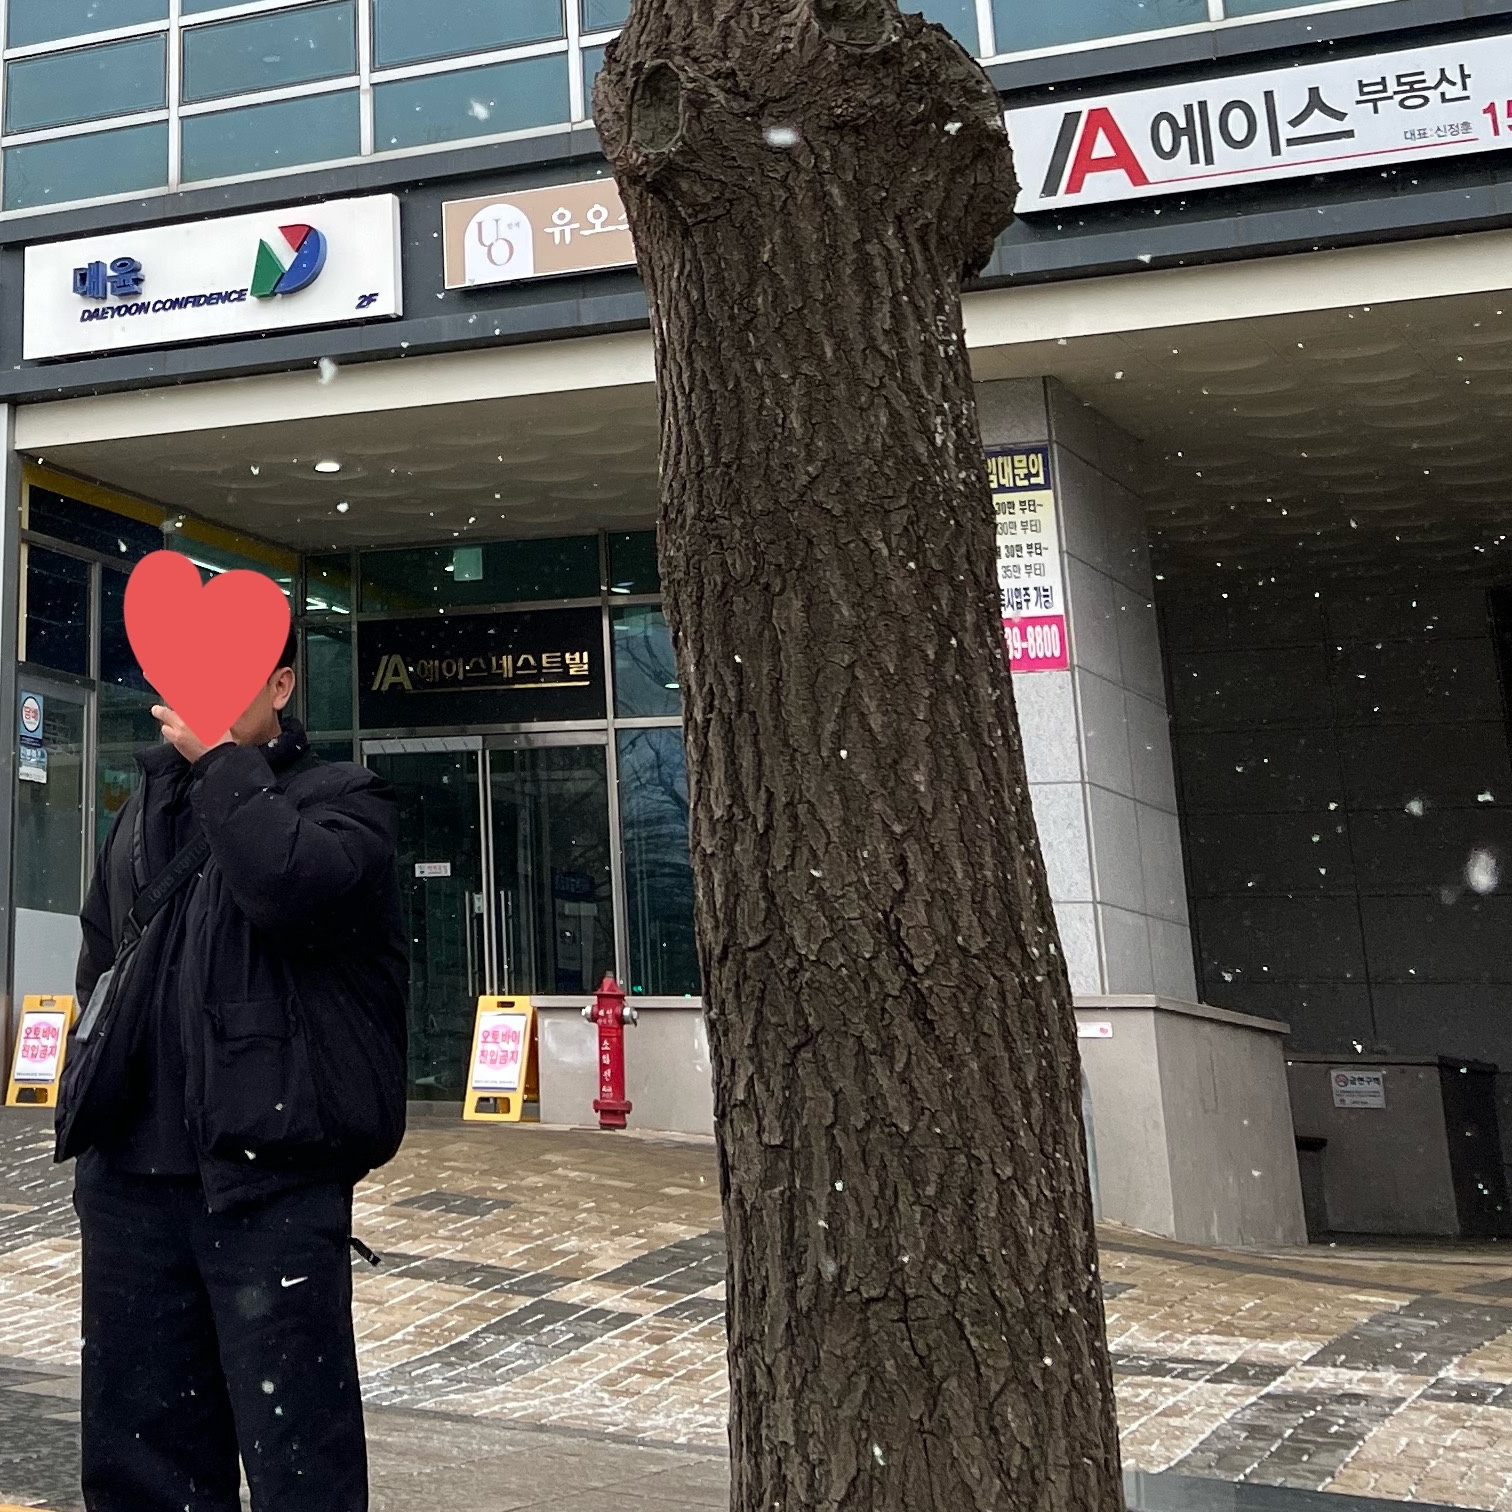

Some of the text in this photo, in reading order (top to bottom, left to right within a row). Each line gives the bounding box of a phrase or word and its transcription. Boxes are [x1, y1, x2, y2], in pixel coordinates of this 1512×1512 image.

[1355, 64, 1471, 115] 부동산
[1150, 87, 1355, 166] 에이스
[80, 288, 248, 322] DAEYOON CONFIDENCE
[355, 292, 379, 310] 2F
[416, 651, 589, 682] 에이스네스트빌
[23, 1026, 60, 1042] 오토바이
[481, 1030, 521, 1045] 오토바이
[479, 1049, 519, 1065] 진입금지
